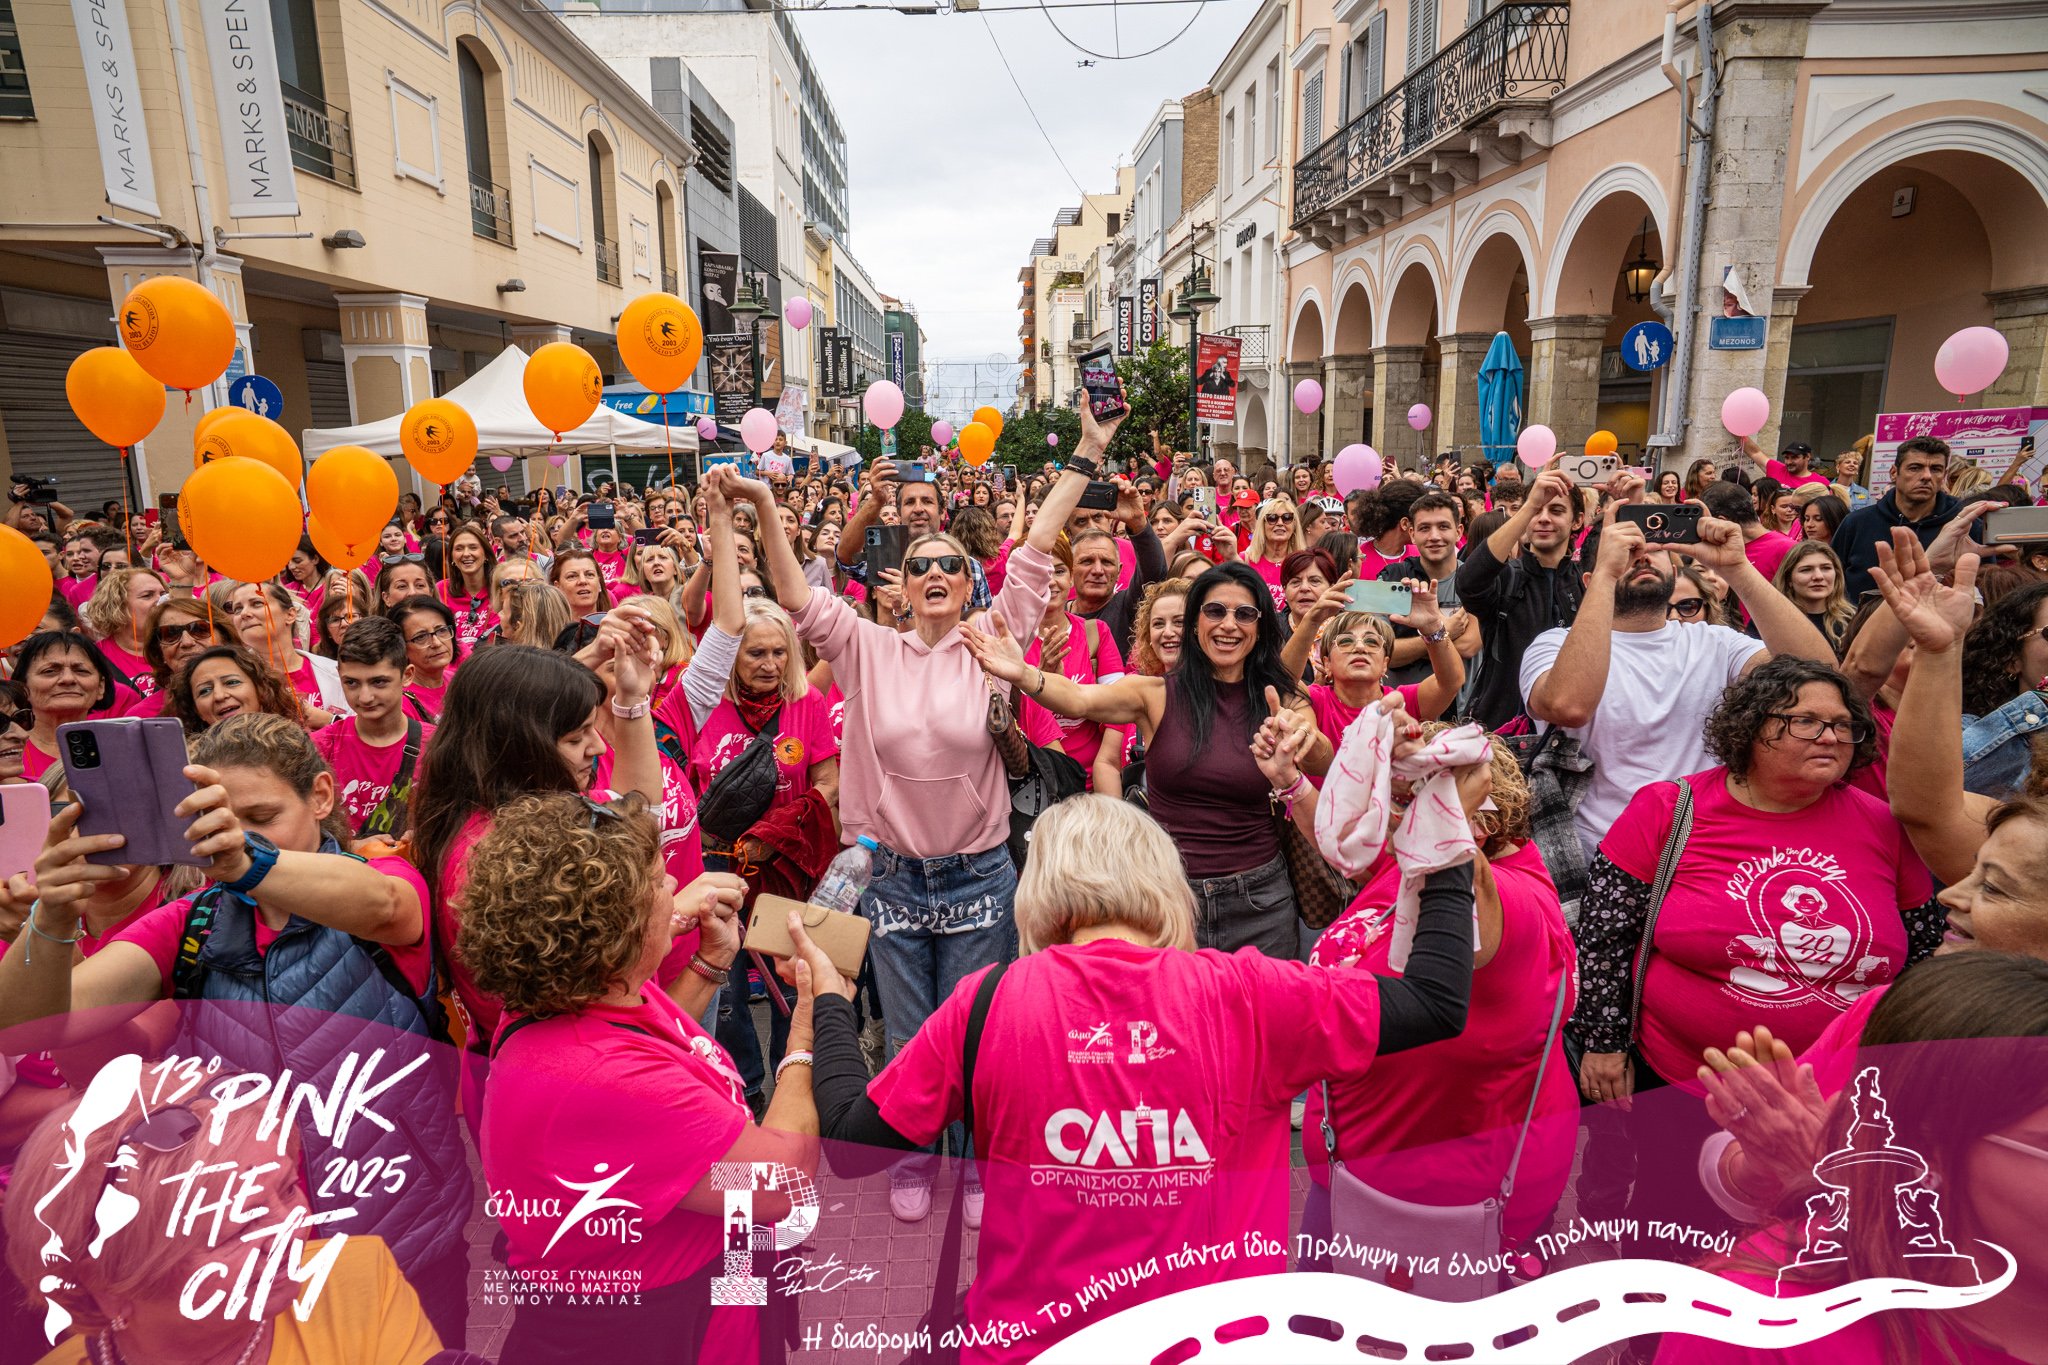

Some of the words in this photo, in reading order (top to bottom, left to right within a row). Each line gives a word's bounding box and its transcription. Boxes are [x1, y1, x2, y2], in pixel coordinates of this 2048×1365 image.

[102, 59, 118, 78] &
[236, 77, 257, 94] &
[106, 84, 138, 191] MARKS
[240, 102, 272, 198] MARKS
[129, 331, 142, 339] 2003
[1120, 300, 1128, 352] COSMOS
[615, 400, 632, 411] free
[1737, 846, 1791, 881] Pink
[1786, 847, 1800, 856] the
[1798, 847, 1848, 882] City
[1795, 934, 1834, 952] 20
[1798, 949, 1836, 966] 24
[1741, 998, 1774, 1010] διαφορά
[1068, 1028, 1091, 1041] άλμα
[1031, 1171, 1143, 1190] ΟΡΓΑΝΙΣΜΟΣ
[1078, 1190, 1148, 1208] ΠΑΤΡΩΝ
[1153, 1190, 1182, 1207] Α.Ε.
